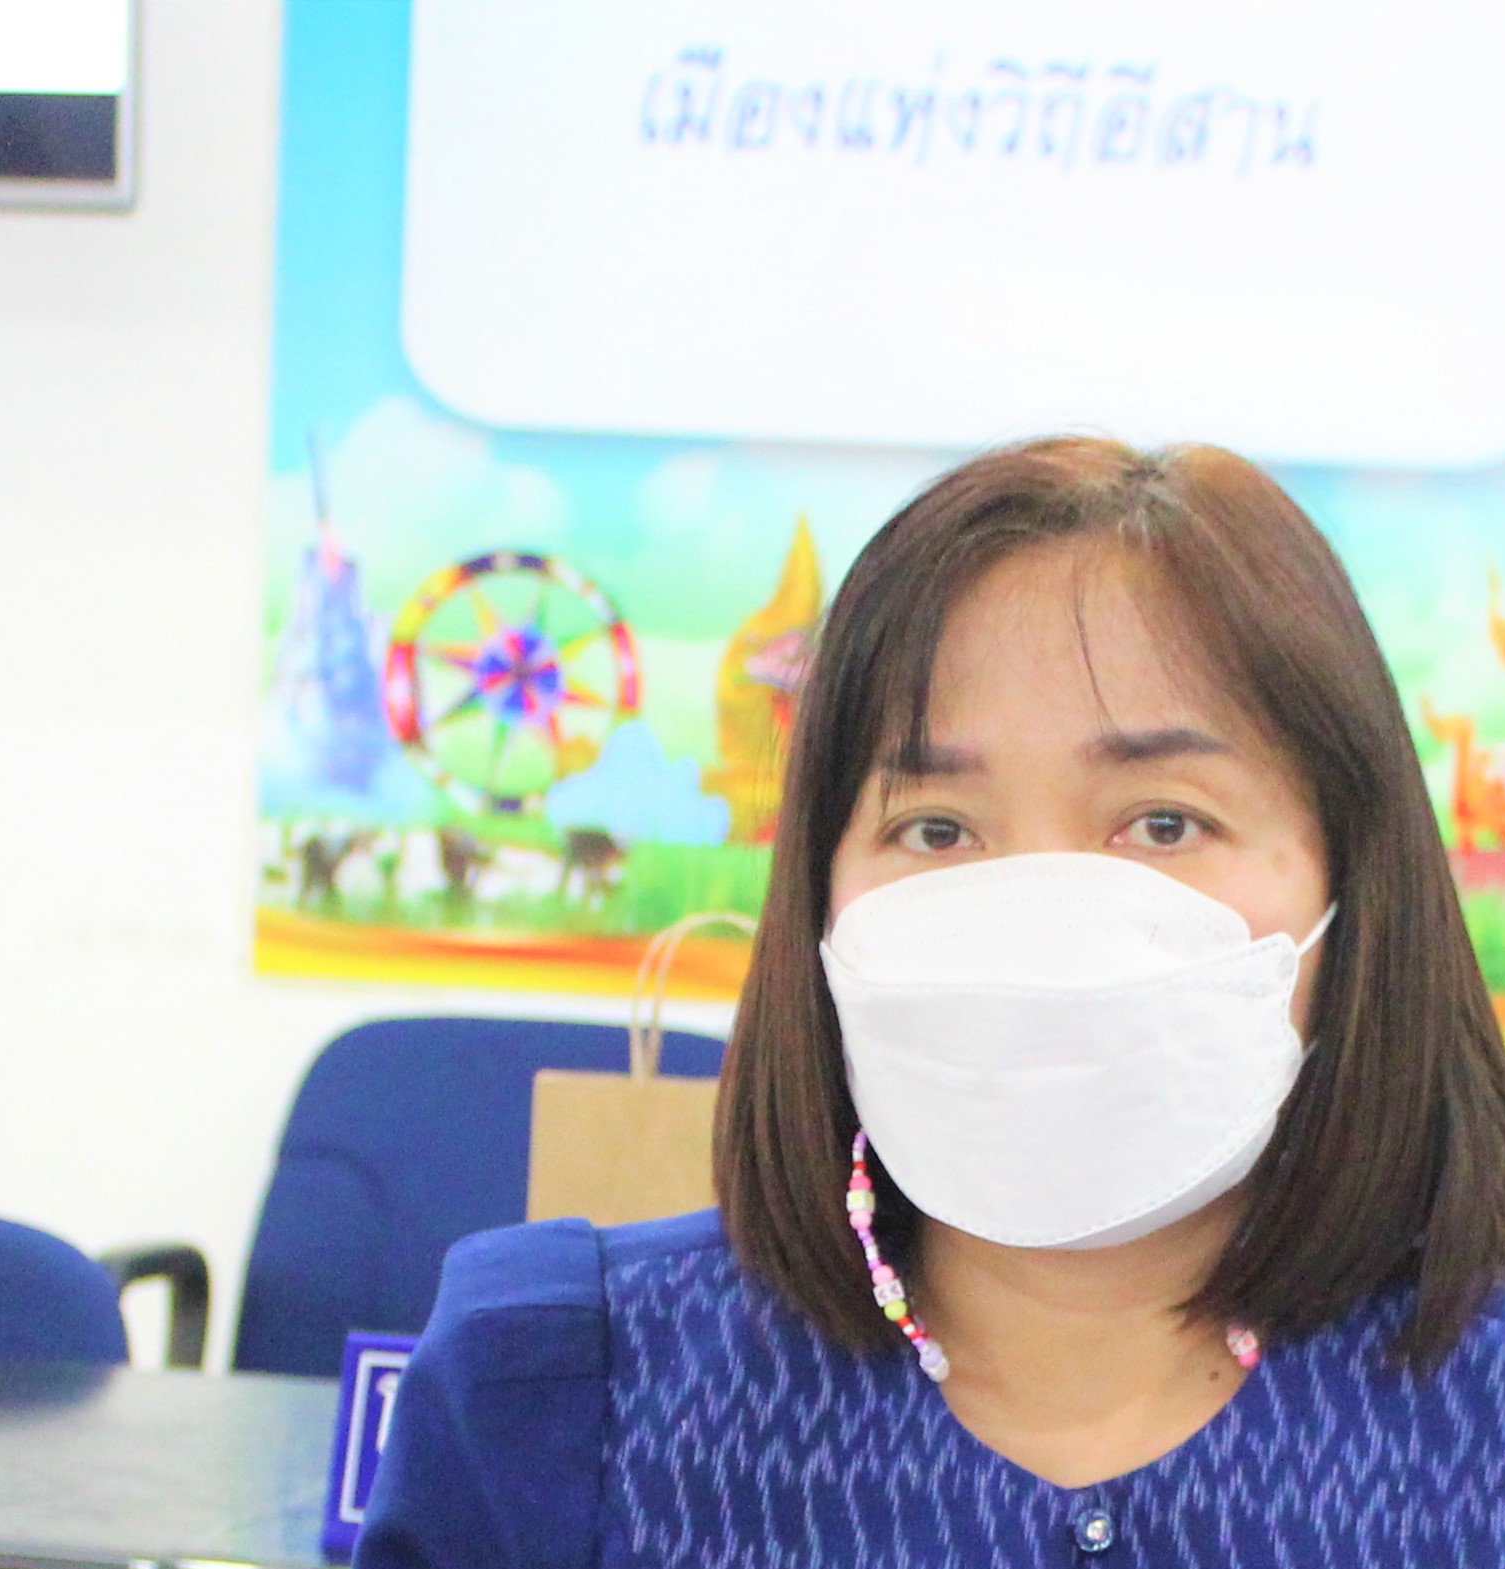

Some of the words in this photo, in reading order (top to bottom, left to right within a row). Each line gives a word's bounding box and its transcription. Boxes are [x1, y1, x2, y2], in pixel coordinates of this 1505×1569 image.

[639, 44, 1320, 175] เมืองแห่งวิถีอีสาน
